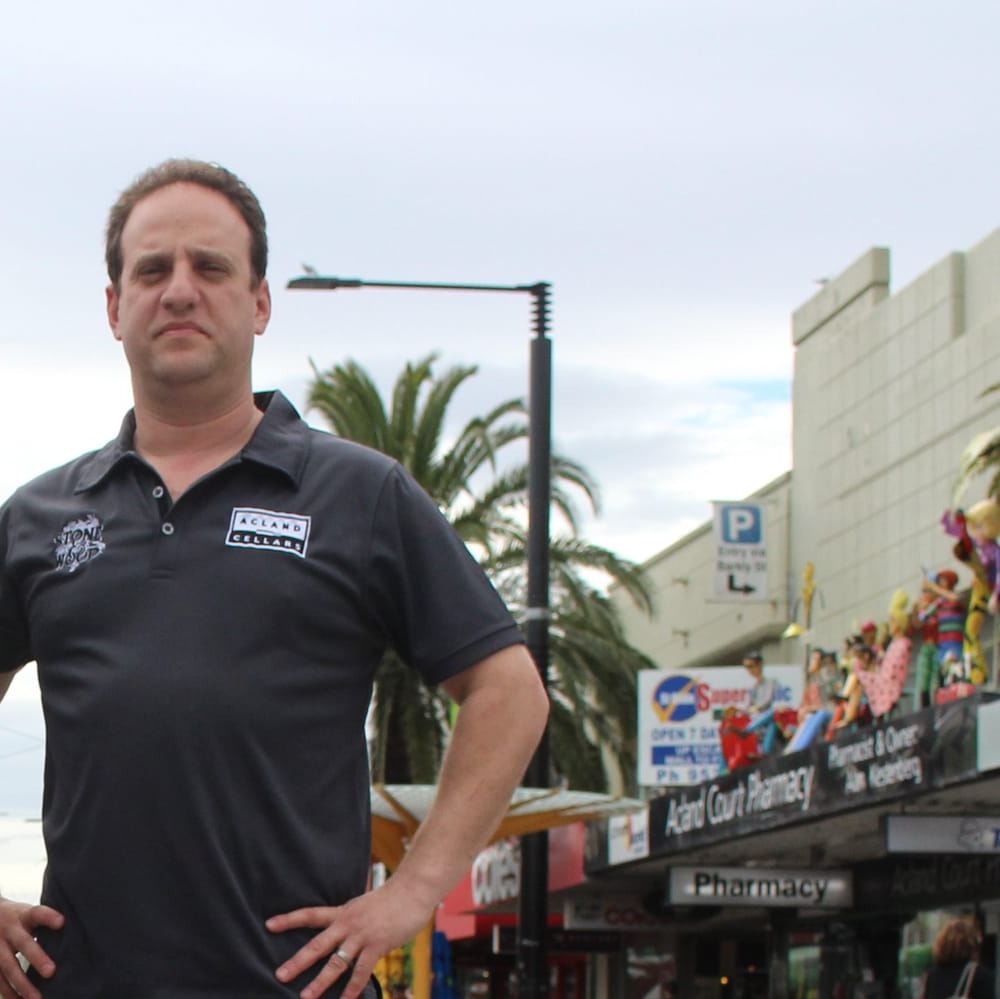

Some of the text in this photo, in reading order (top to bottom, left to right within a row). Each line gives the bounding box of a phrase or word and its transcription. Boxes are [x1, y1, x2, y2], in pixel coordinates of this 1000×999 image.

[240, 517, 301, 532] ACLAND
[728, 509, 755, 541] P
[232, 534, 302, 552] CELLARS
[652, 727, 685, 741] OPEN
[665, 765, 815, 837] Acland Court Pharmacy
[693, 872, 829, 902] Pharmacy
